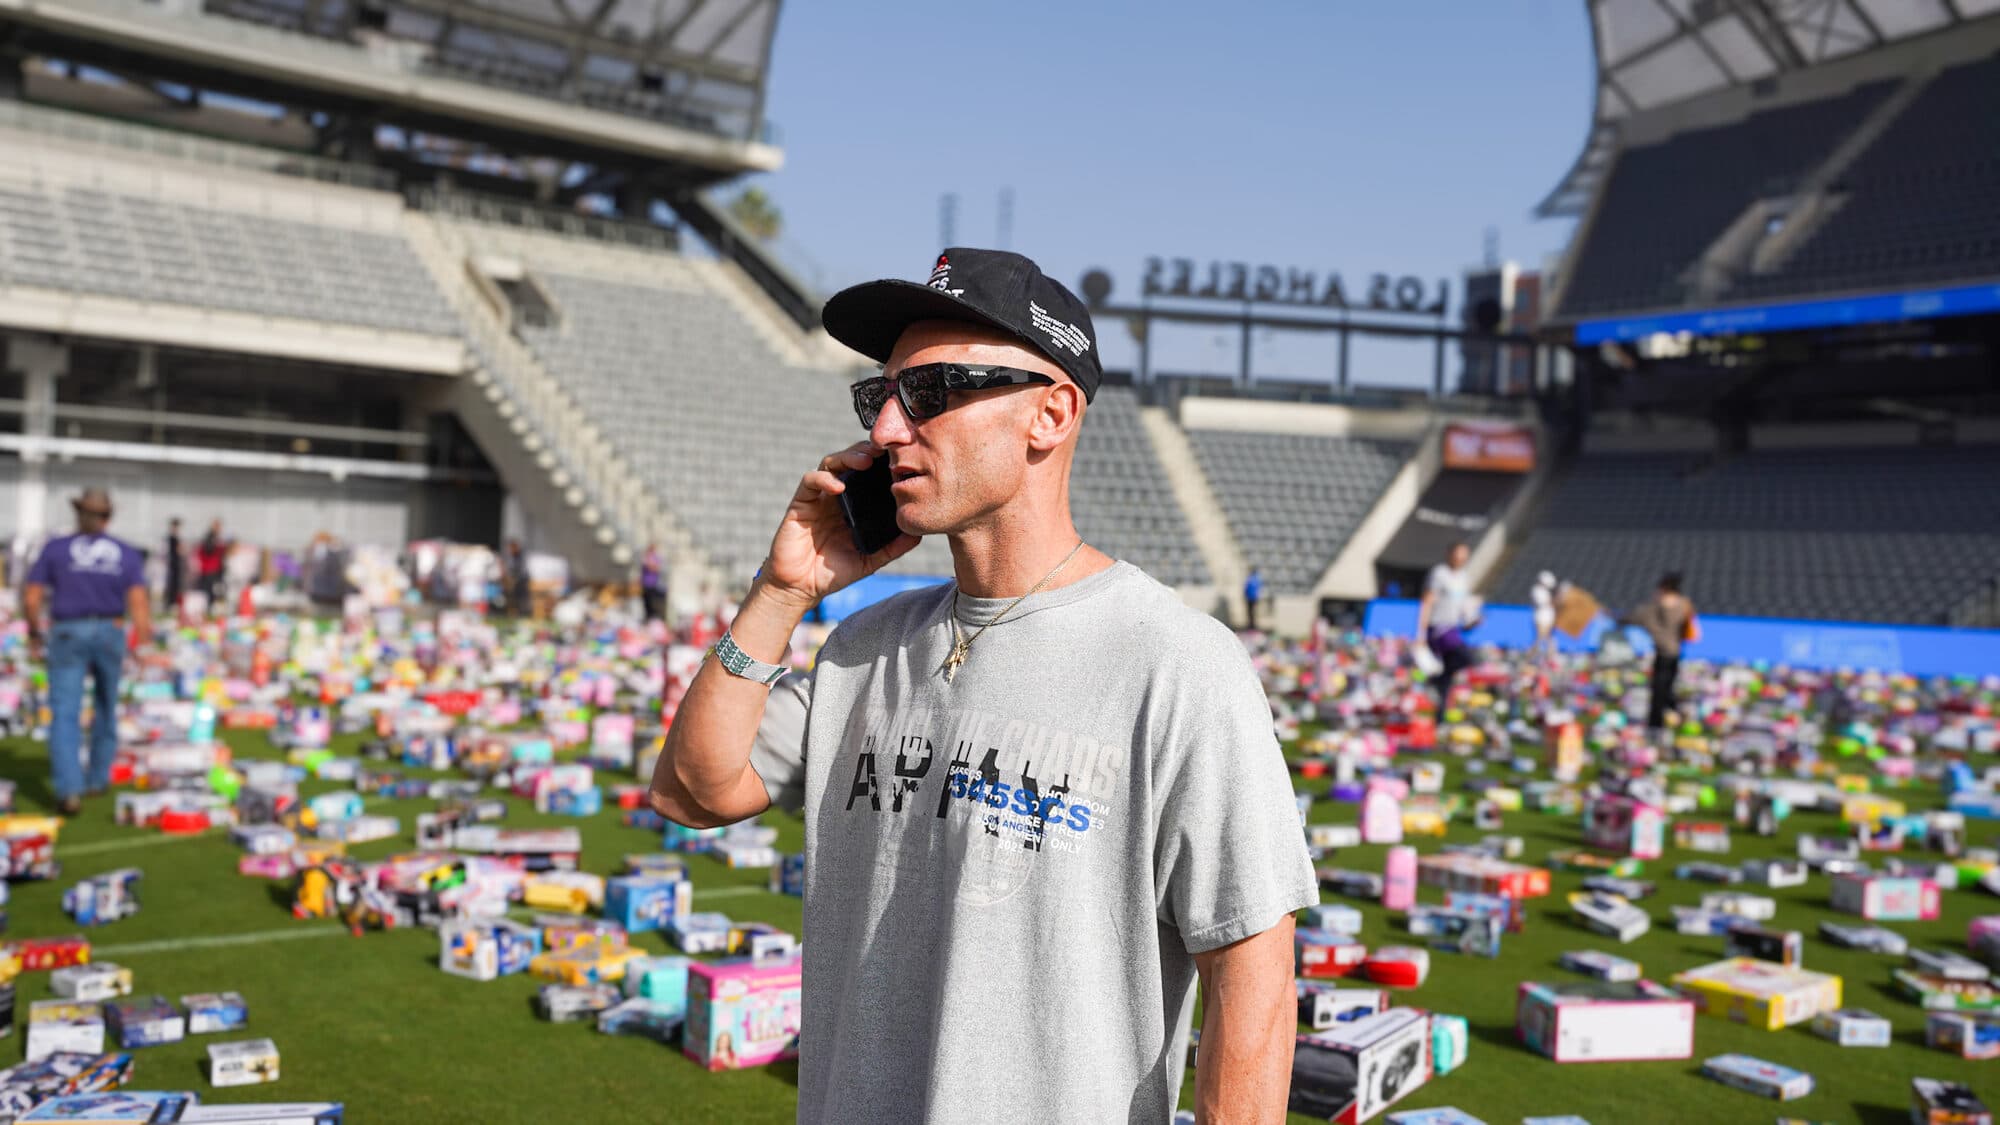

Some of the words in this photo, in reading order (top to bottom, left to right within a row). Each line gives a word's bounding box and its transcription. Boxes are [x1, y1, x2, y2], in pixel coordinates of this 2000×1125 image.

[999, 719, 1124, 800] CHAOS
[951, 773, 1091, 832] 545SCS
[998, 838, 1024, 854] 2025
[1051, 838, 1082, 855] ONLY
